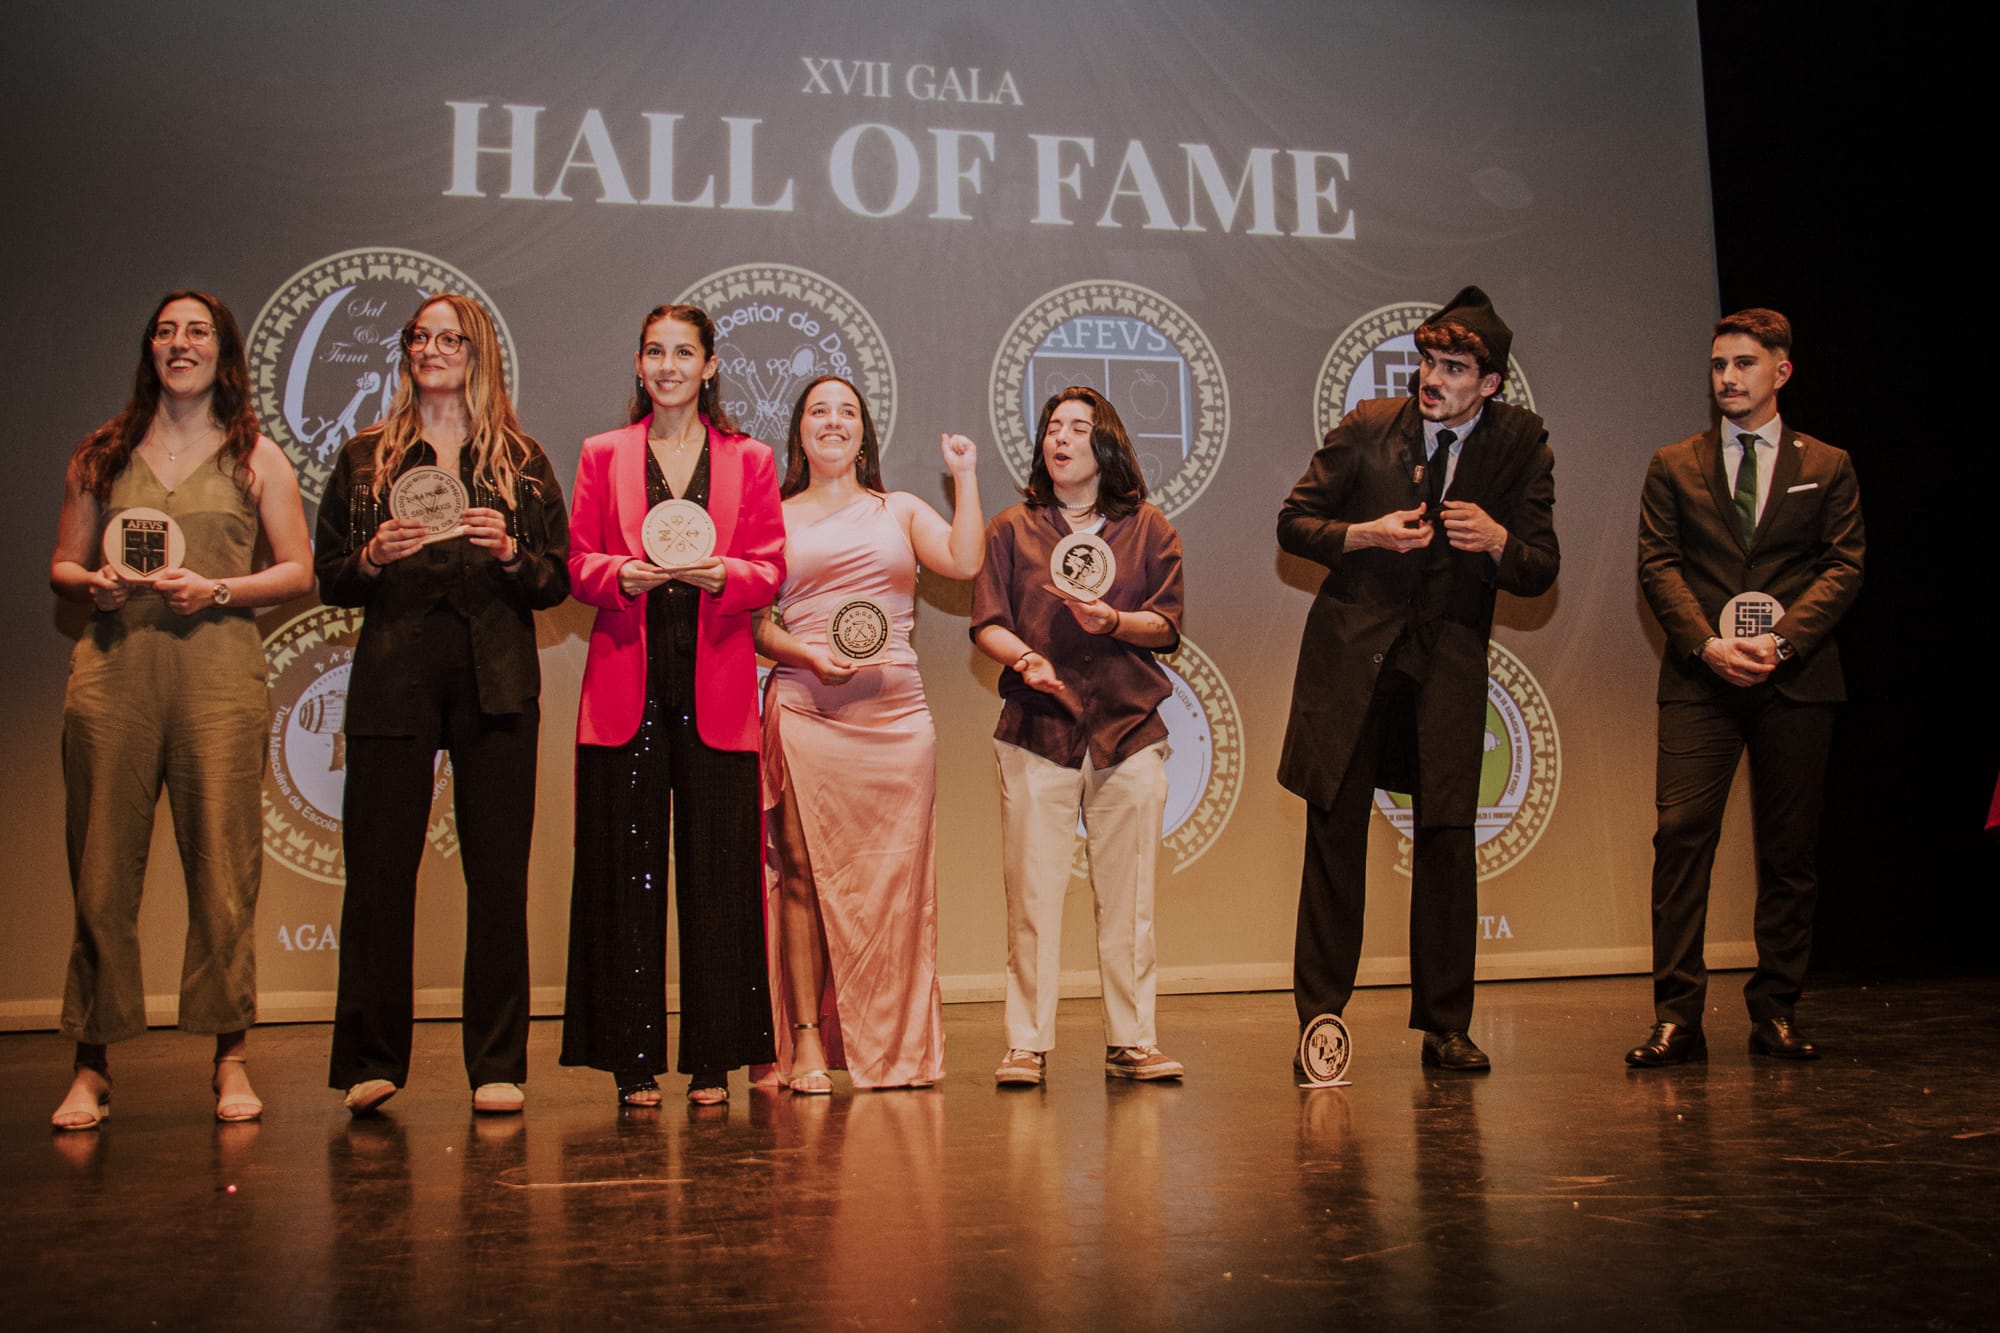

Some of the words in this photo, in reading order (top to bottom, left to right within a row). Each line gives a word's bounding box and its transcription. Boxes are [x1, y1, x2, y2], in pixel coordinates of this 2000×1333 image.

[801, 57, 892, 98] XVII
[906, 63, 1024, 106] GALA
[442, 100, 794, 213] HALL
[829, 122, 996, 222] OF
[1028, 133, 1356, 241] FAME
[348, 298, 387, 317] Sal
[714, 302, 784, 341] uperior
[788, 312, 820, 337] de
[320, 342, 369, 362] Tuna
[1043, 318, 1167, 352] AFEVS
[127, 520, 164, 530] AFEVS
[269, 736, 292, 796] Masculina
[288, 795, 303, 811] da
[301, 806, 338, 832] Escola
